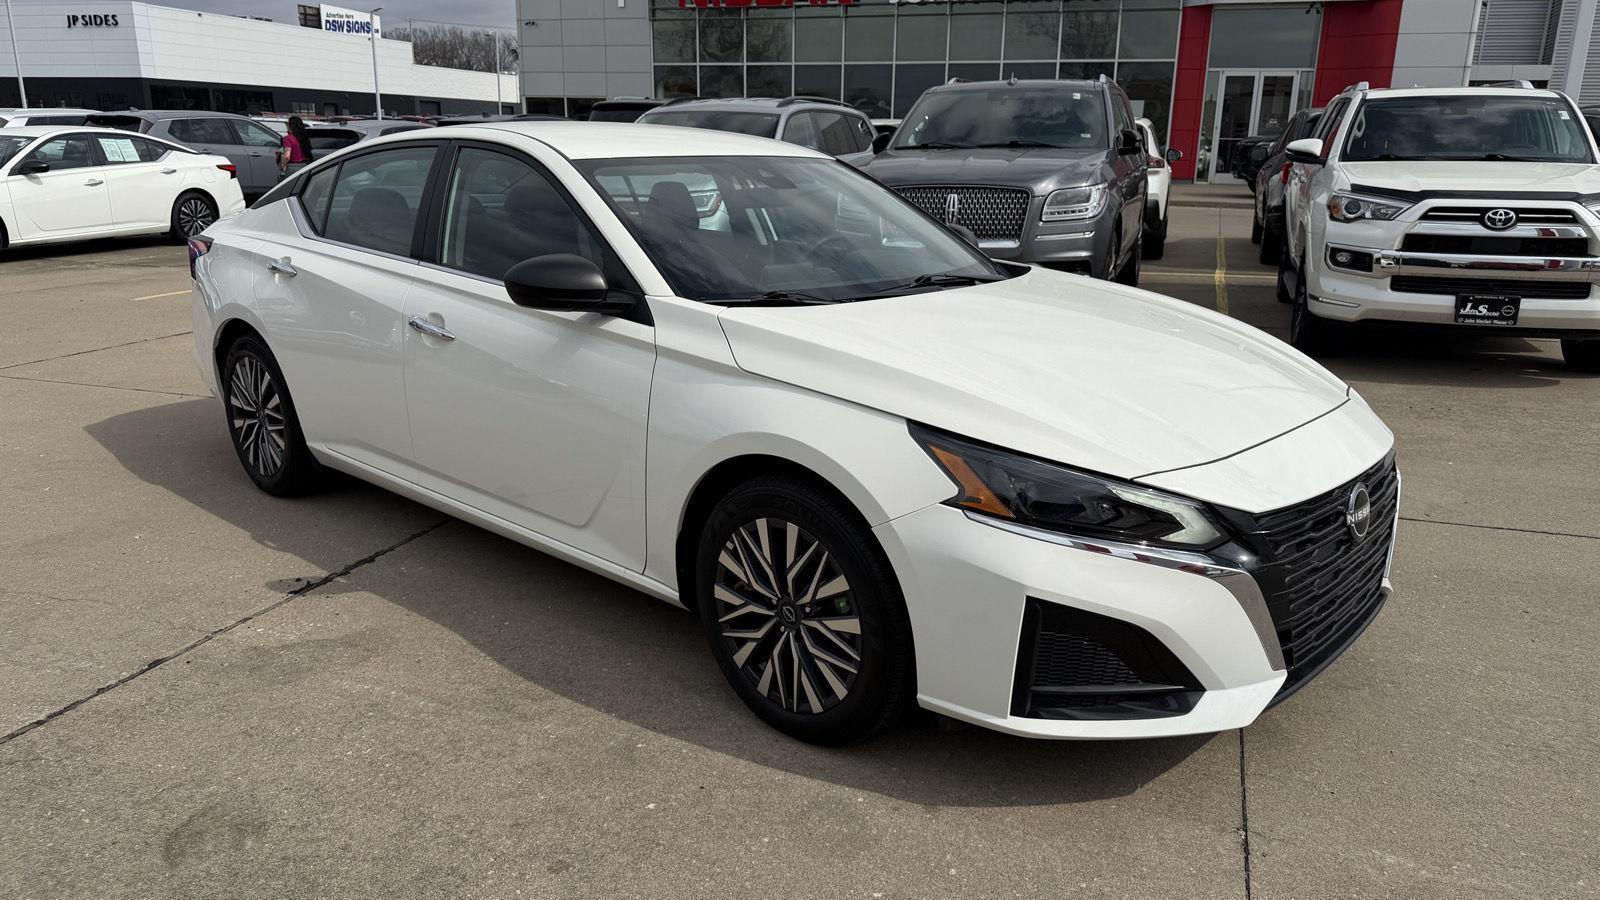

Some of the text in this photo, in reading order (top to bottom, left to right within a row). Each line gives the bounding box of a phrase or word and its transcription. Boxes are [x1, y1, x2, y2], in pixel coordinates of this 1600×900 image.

[67, 14, 119, 28] JP SIDES
[325, 19, 371, 34] DSW SIGNS
